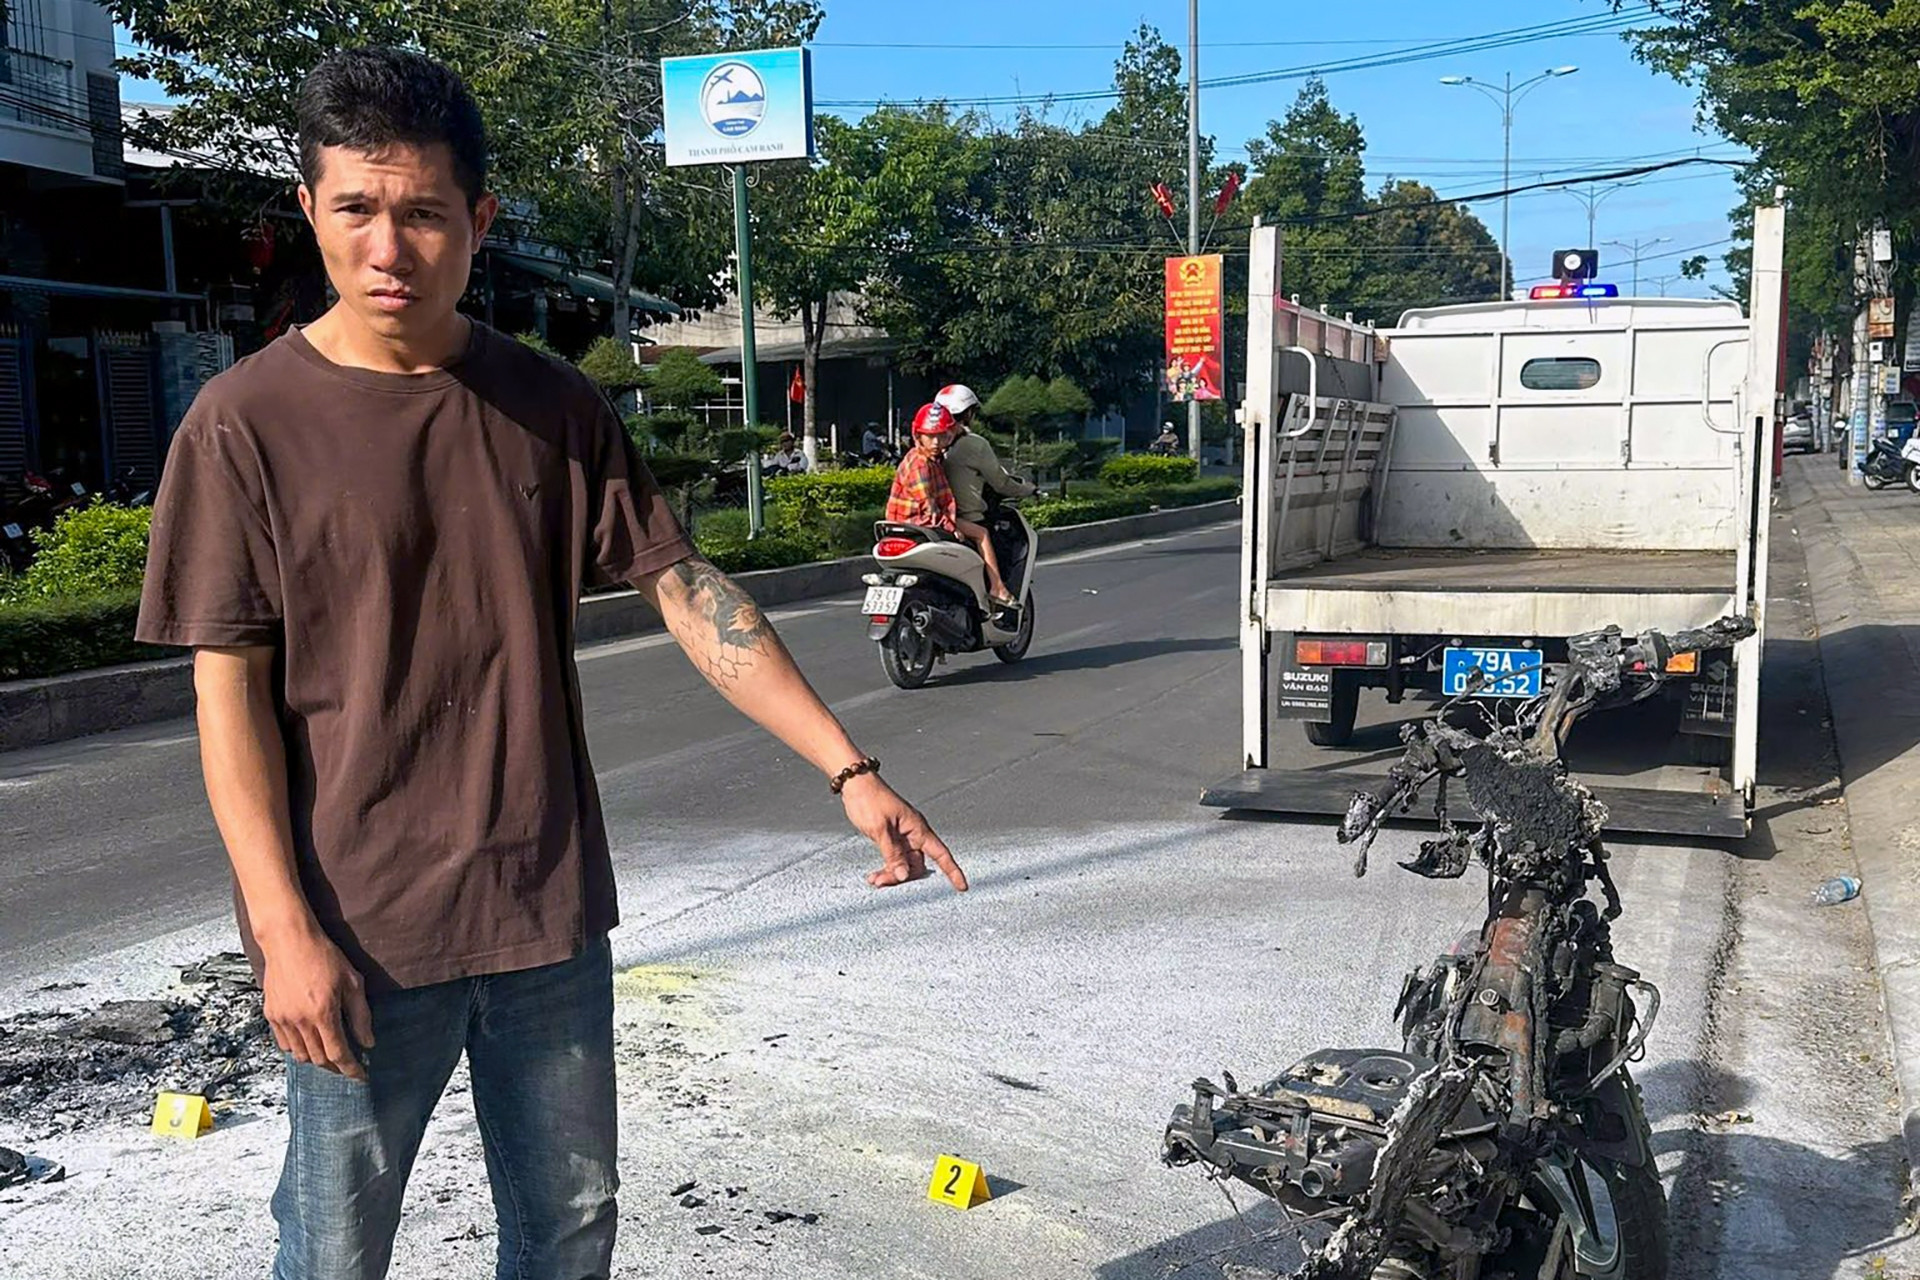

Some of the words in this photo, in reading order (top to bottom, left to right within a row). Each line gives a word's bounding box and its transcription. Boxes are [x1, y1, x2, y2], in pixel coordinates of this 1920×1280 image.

[1472, 651, 1513, 672] 79A
[1282, 671, 1329, 683] SUZUKI
[943, 1165, 962, 1195] 2
